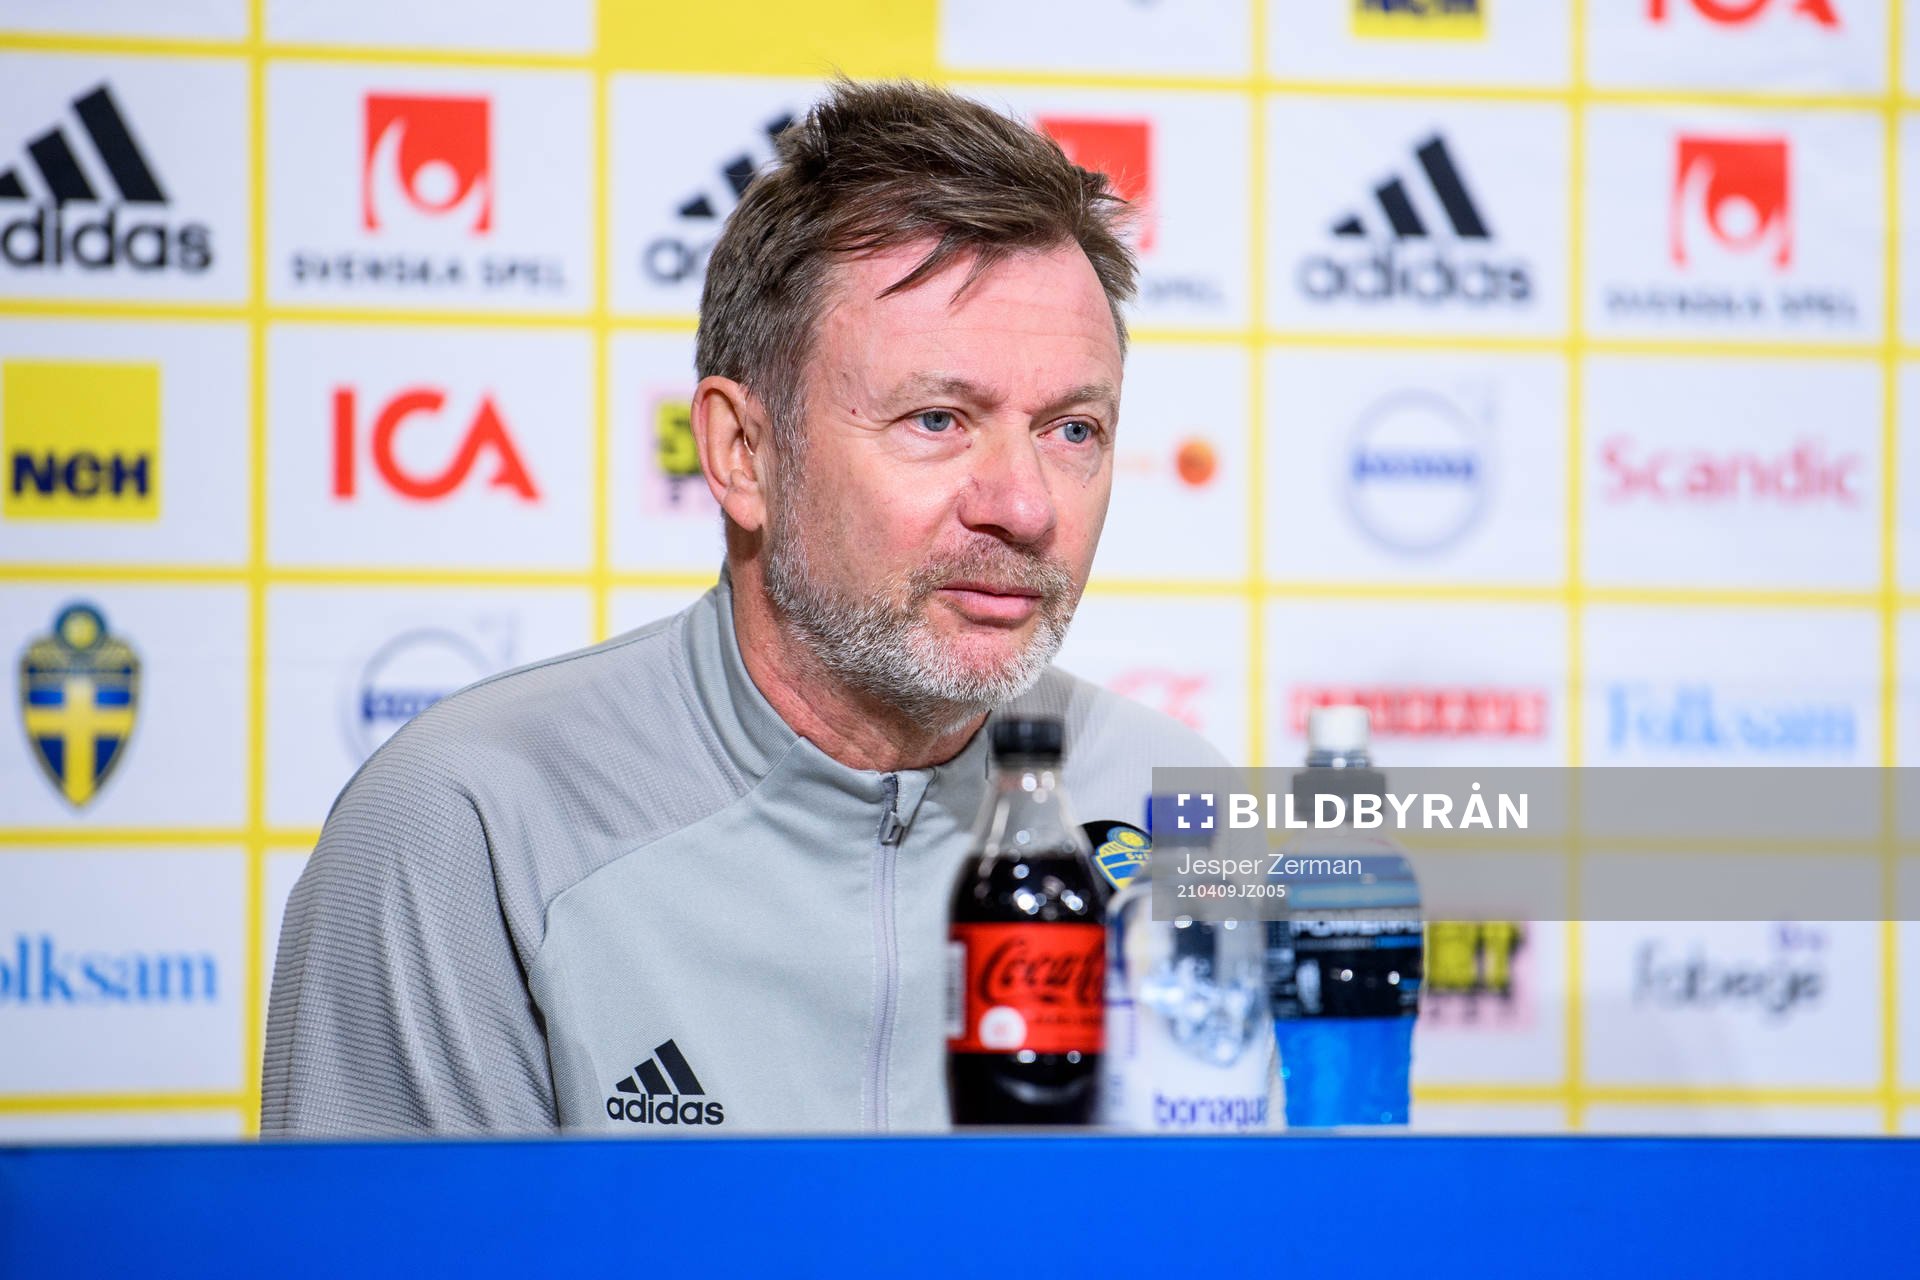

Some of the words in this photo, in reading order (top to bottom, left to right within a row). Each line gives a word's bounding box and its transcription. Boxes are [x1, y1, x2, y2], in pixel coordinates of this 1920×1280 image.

[0, 206, 213, 275] didas
[1299, 239, 1533, 304] adidas
[332, 386, 541, 501] ICA
[1602, 437, 1862, 506] Scandic
[0, 934, 216, 1002] lksam
[606, 1093, 725, 1126] adidas
[1154, 1091, 1269, 1134] bonaqu
